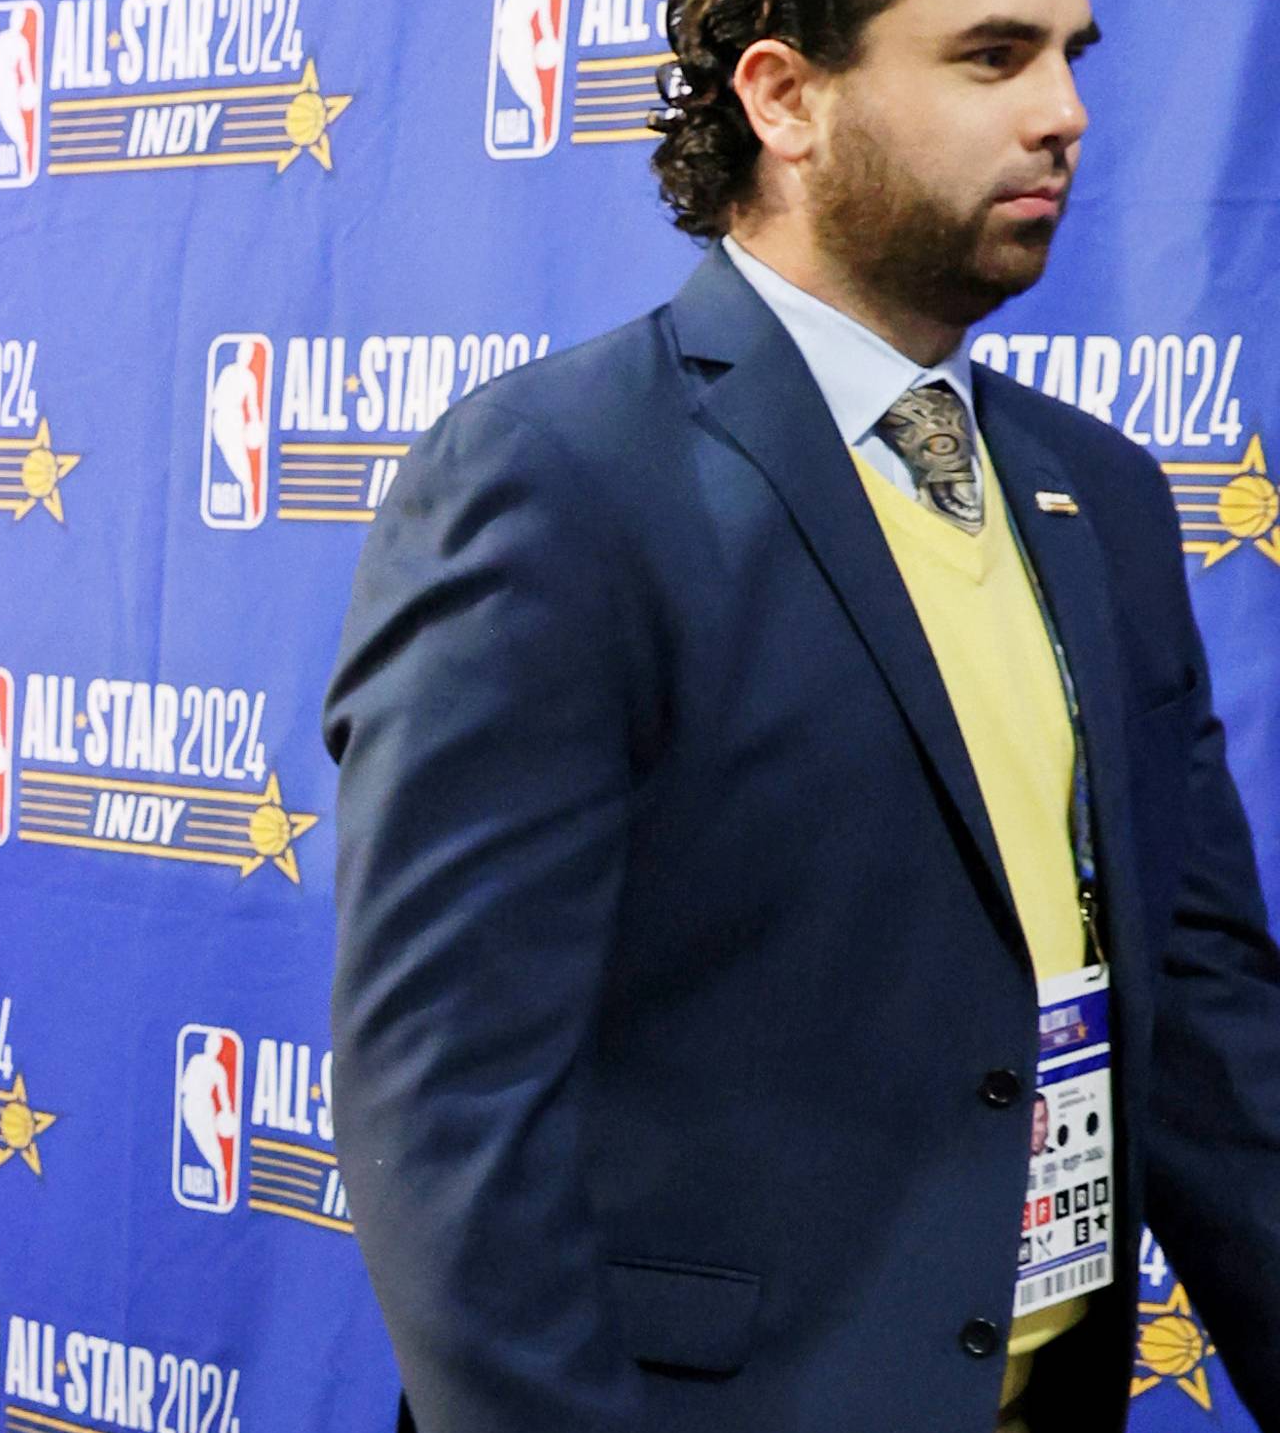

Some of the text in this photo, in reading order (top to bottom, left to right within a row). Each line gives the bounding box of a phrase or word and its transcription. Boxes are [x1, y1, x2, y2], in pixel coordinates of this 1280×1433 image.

[126, 102, 223, 158] INDY
[1122, 333, 1244, 447] 2024
[178, 685, 267, 783] 2024
[92, 791, 187, 846] INDY
